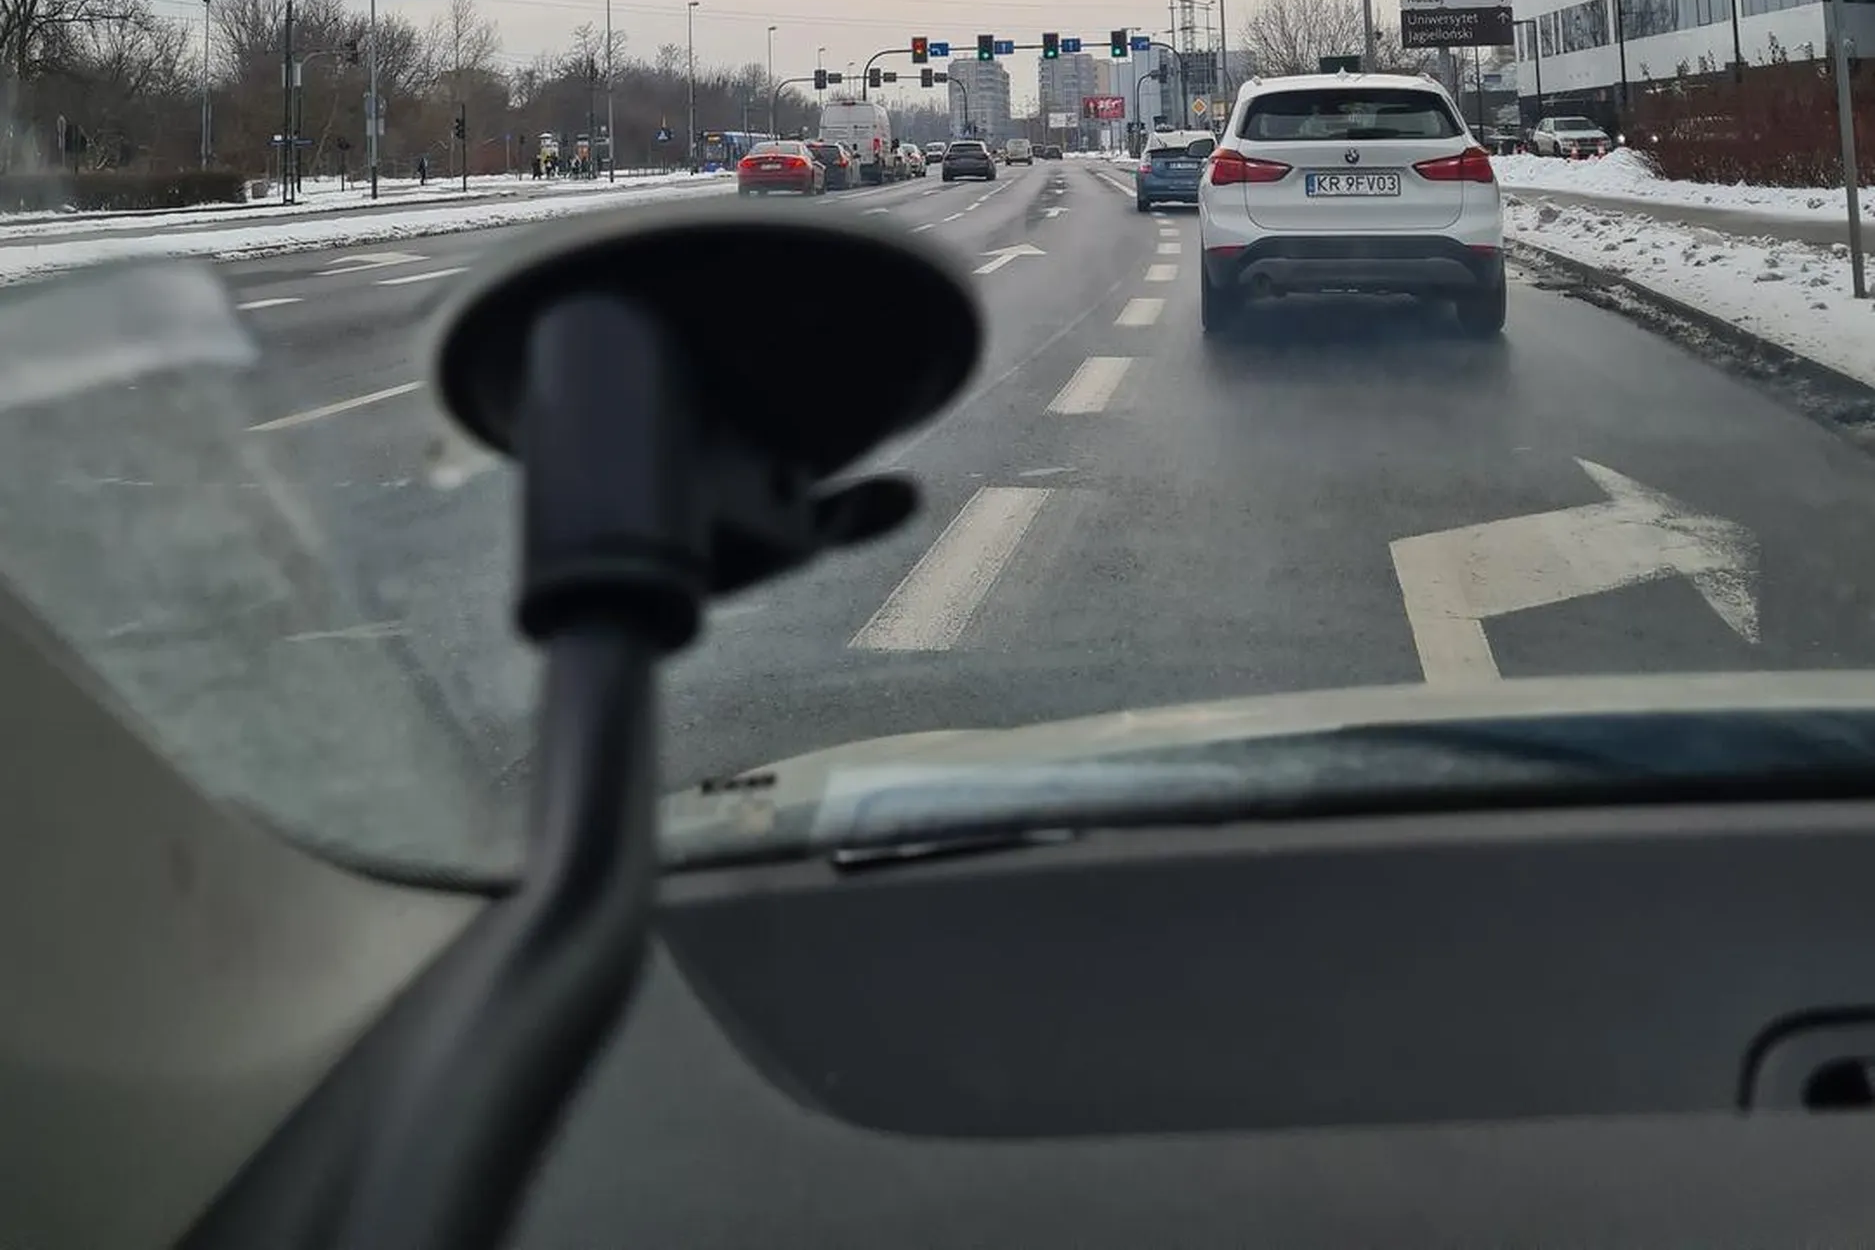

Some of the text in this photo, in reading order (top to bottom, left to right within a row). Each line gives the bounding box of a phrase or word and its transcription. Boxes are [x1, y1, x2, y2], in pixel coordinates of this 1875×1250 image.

[1407, 13, 1479, 27] Uniwersytet
[1317, 176, 1397, 192] KR 9FV03
